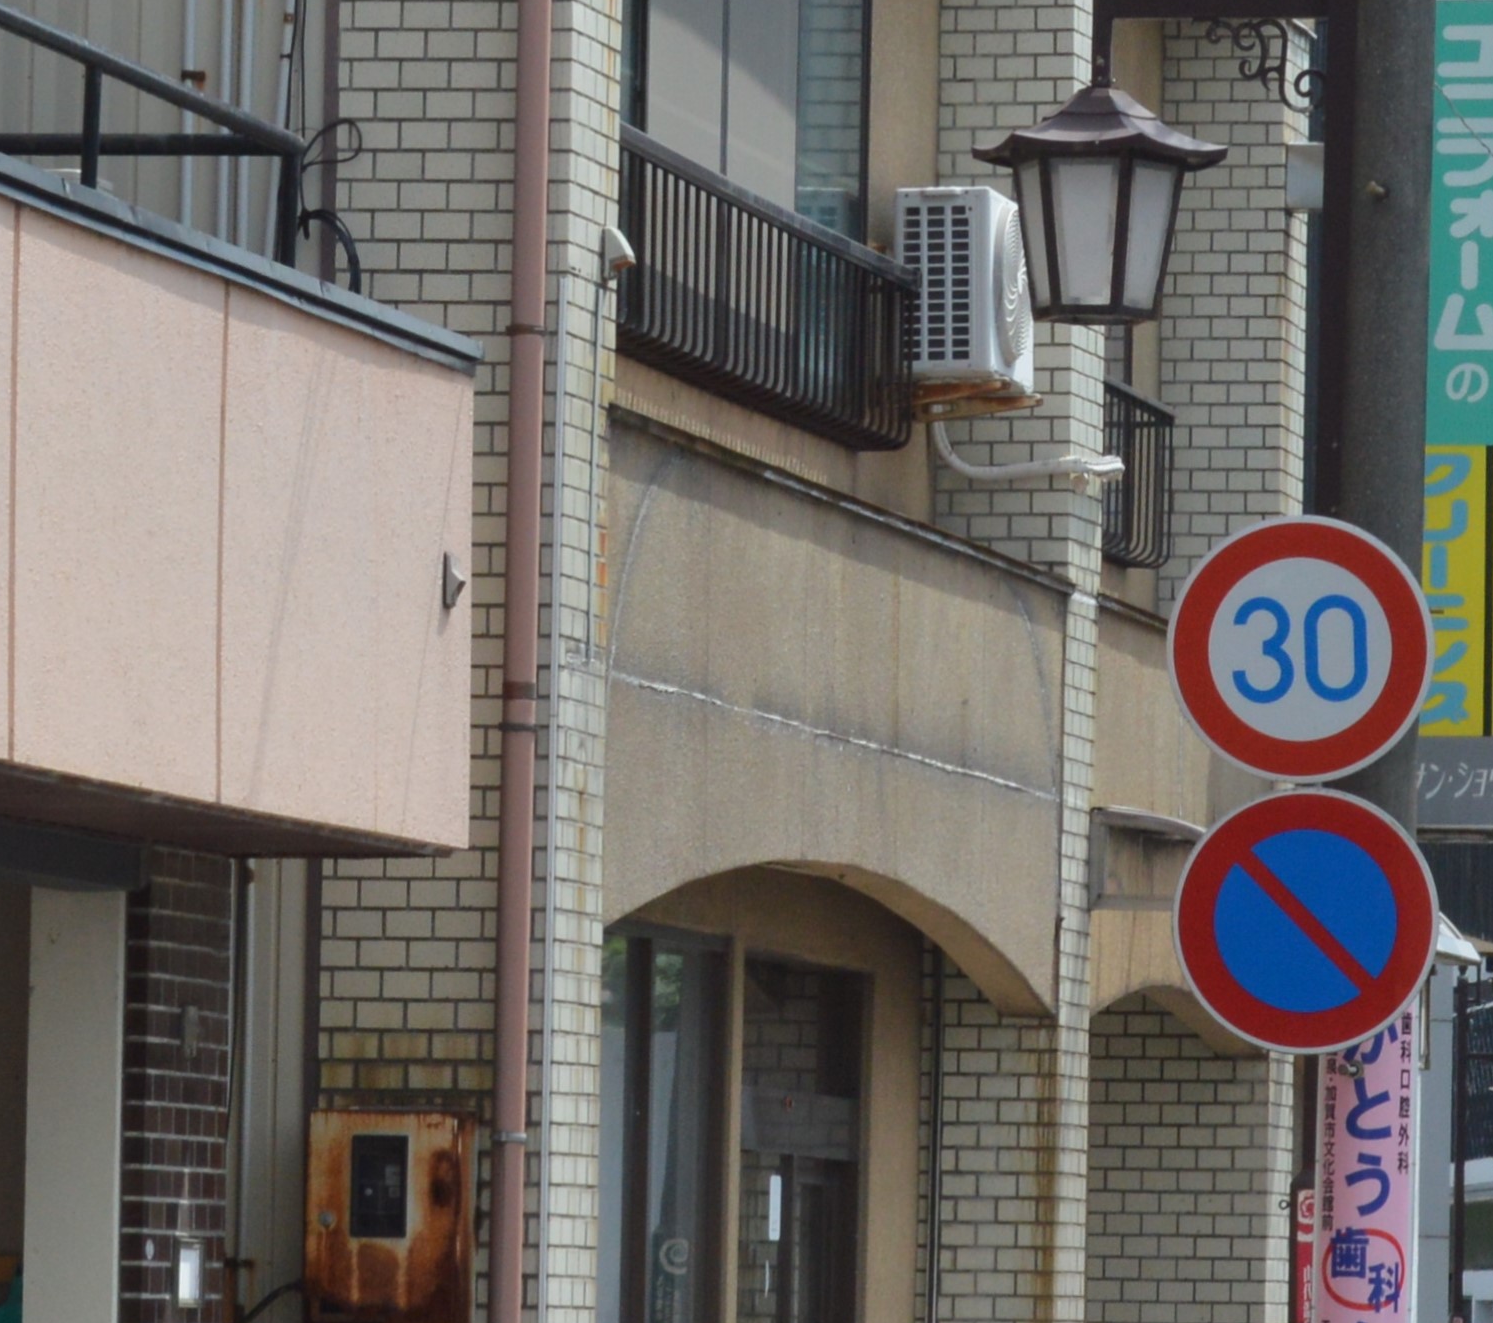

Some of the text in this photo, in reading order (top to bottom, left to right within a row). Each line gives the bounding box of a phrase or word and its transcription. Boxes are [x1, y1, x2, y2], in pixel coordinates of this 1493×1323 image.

[1232, 593, 1369, 704] 30
[1321, 1052, 1338, 1231] 泉・加賀市文化会館前
